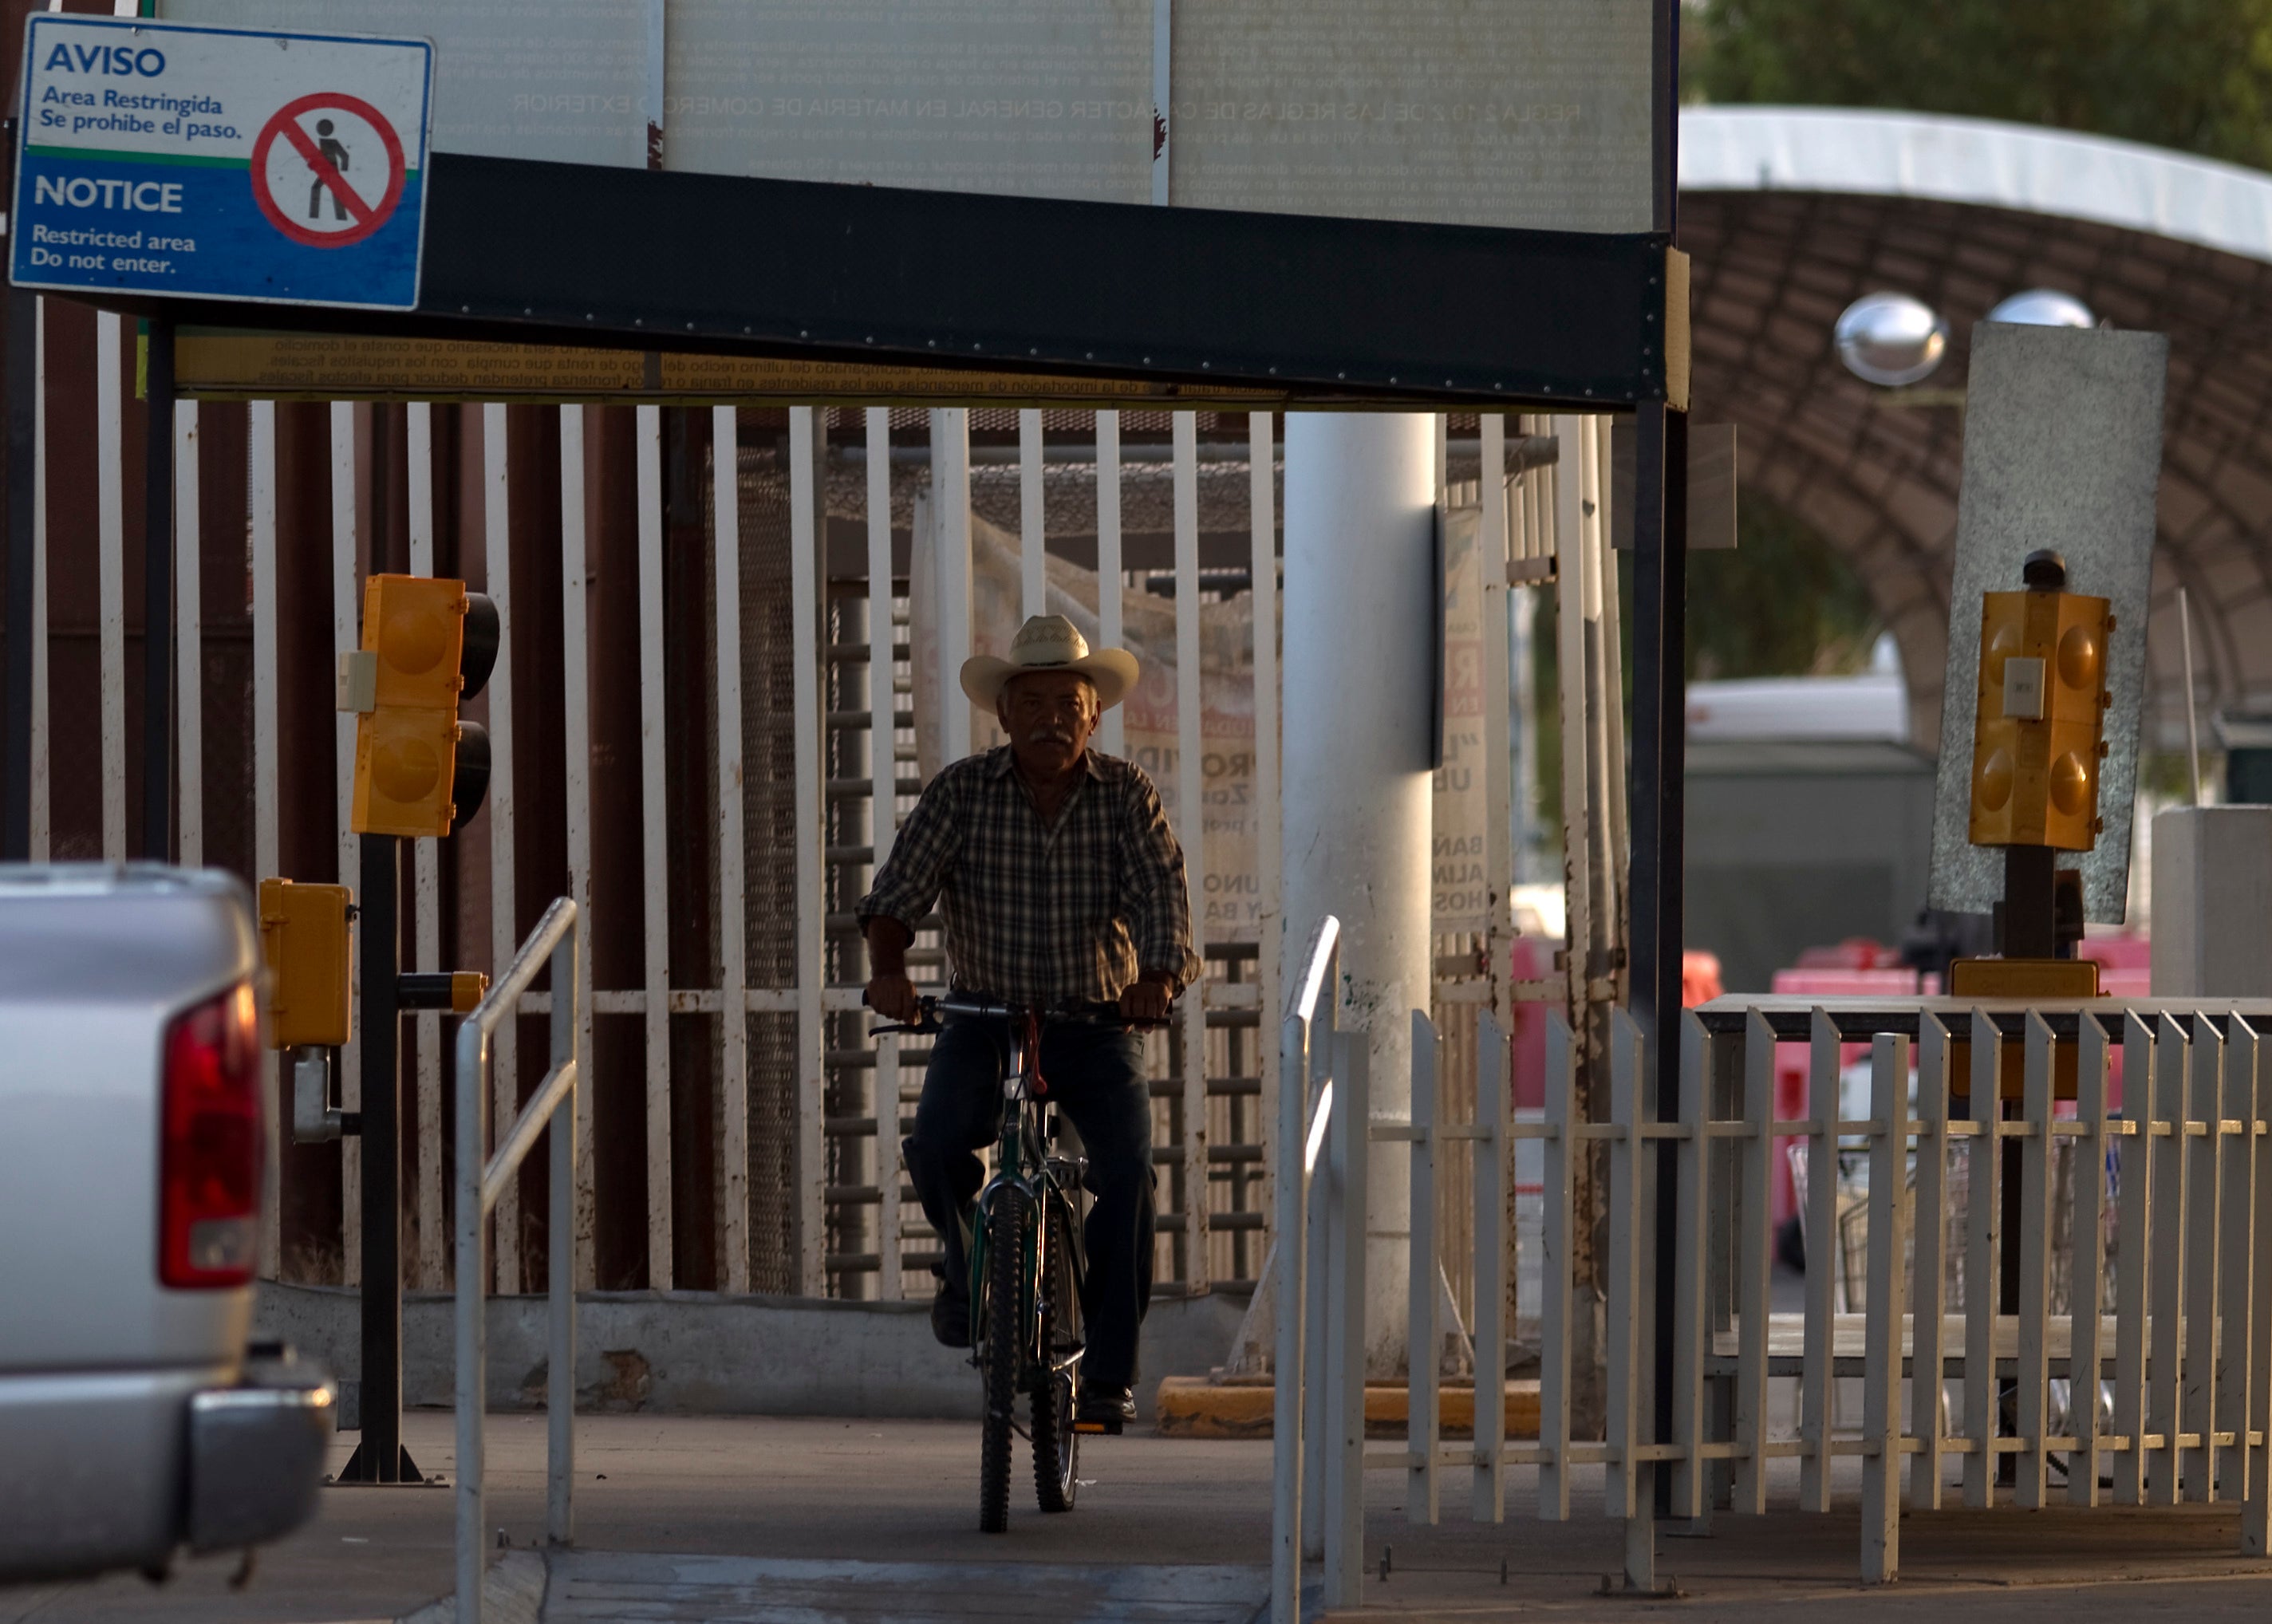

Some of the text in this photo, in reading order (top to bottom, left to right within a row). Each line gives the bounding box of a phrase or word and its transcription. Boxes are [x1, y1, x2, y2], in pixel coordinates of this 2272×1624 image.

[44, 43, 166, 77] AVISO
[42, 85, 223, 117] Area Restringida
[40, 108, 242, 140] Se prohibe el paso.
[35, 175, 183, 213] NOTICE
[33, 224, 195, 252] Restricted area
[30, 248, 176, 274] Do not enter.
